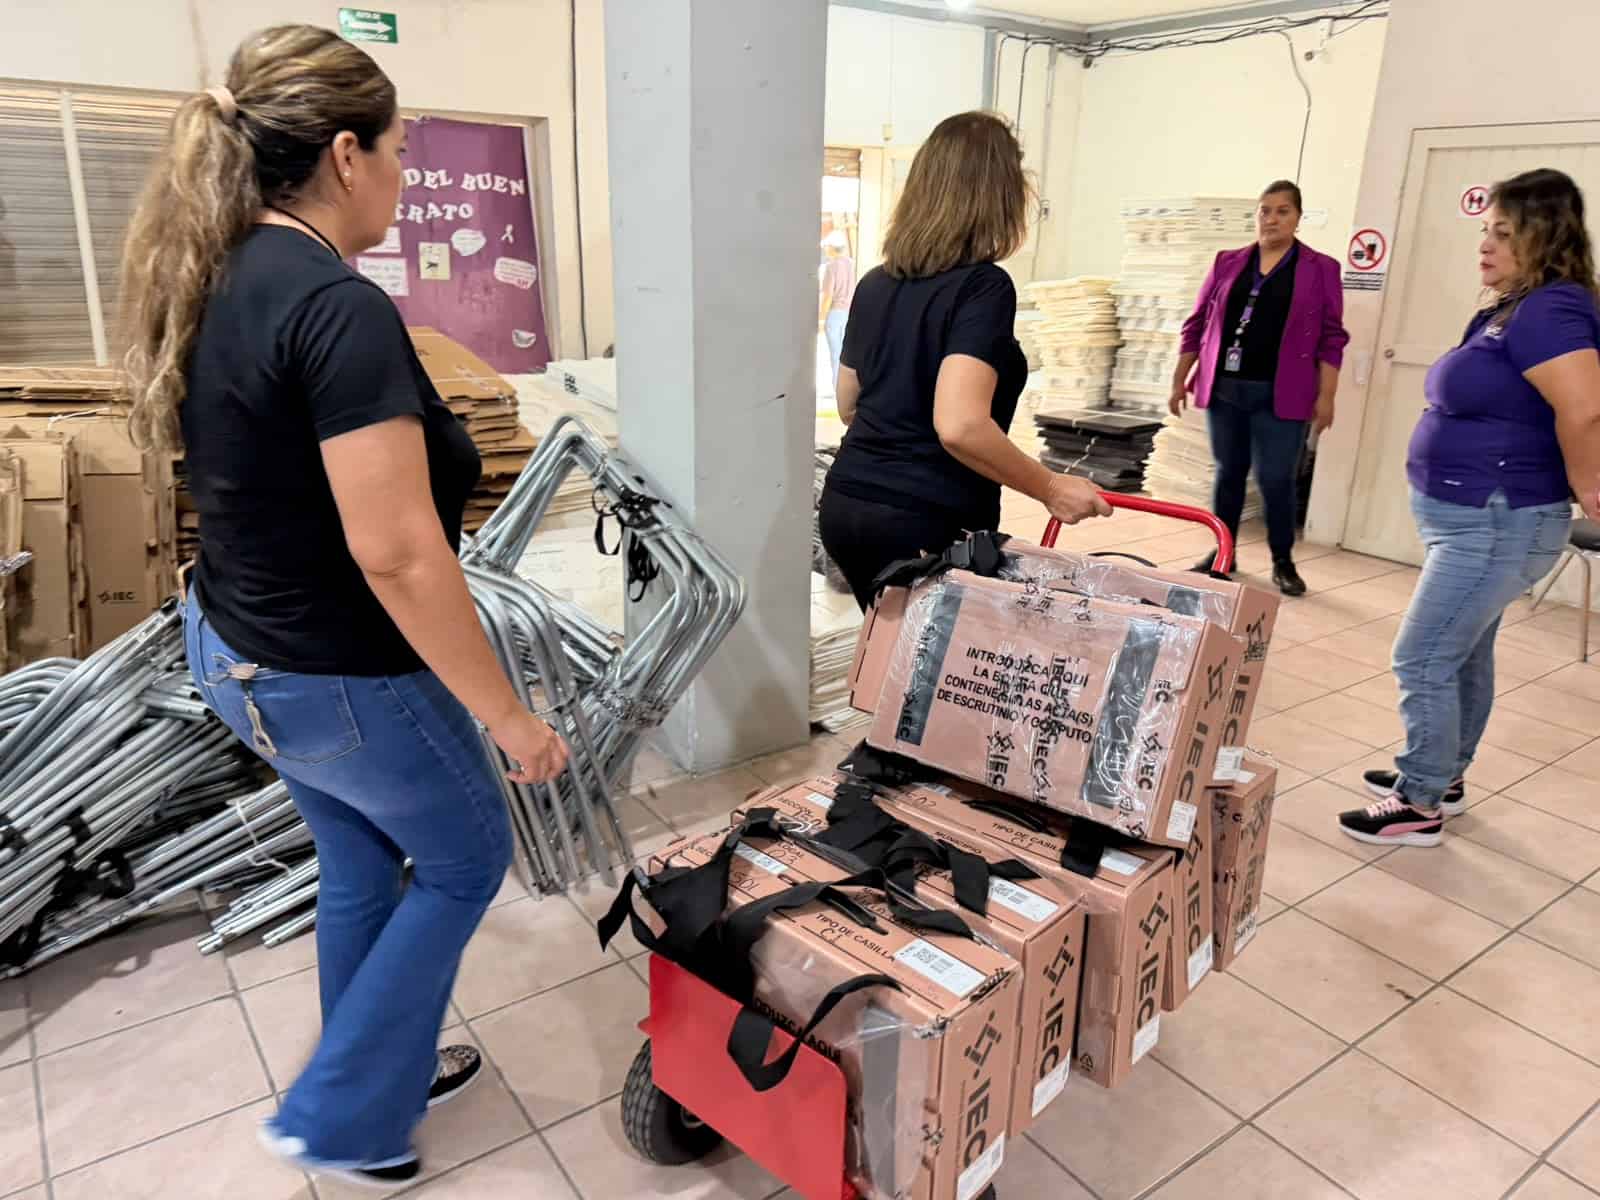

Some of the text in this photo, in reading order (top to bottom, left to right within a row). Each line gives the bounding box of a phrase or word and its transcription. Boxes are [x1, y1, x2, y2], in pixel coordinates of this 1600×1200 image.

[403, 167, 525, 196] DEL BUEN
[937, 689, 951, 701] DE
[953, 693, 1019, 721] ESCRUTINIO
[973, 665, 989, 678] LA
[1223, 675, 1250, 747] IEC
[1179, 720, 1209, 801] IEC
[991, 822, 1014, 834] TIPO
[1014, 831, 1029, 841] DE
[816, 913, 838, 930] TIPO
[839, 926, 854, 939] DE
[854, 935, 895, 963] CASILLA
[1187, 881, 1200, 954] IEC
[1137, 952, 1160, 1030] IEC
[1040, 998, 1065, 1081] IEC
[963, 1078, 992, 1169] IEC
